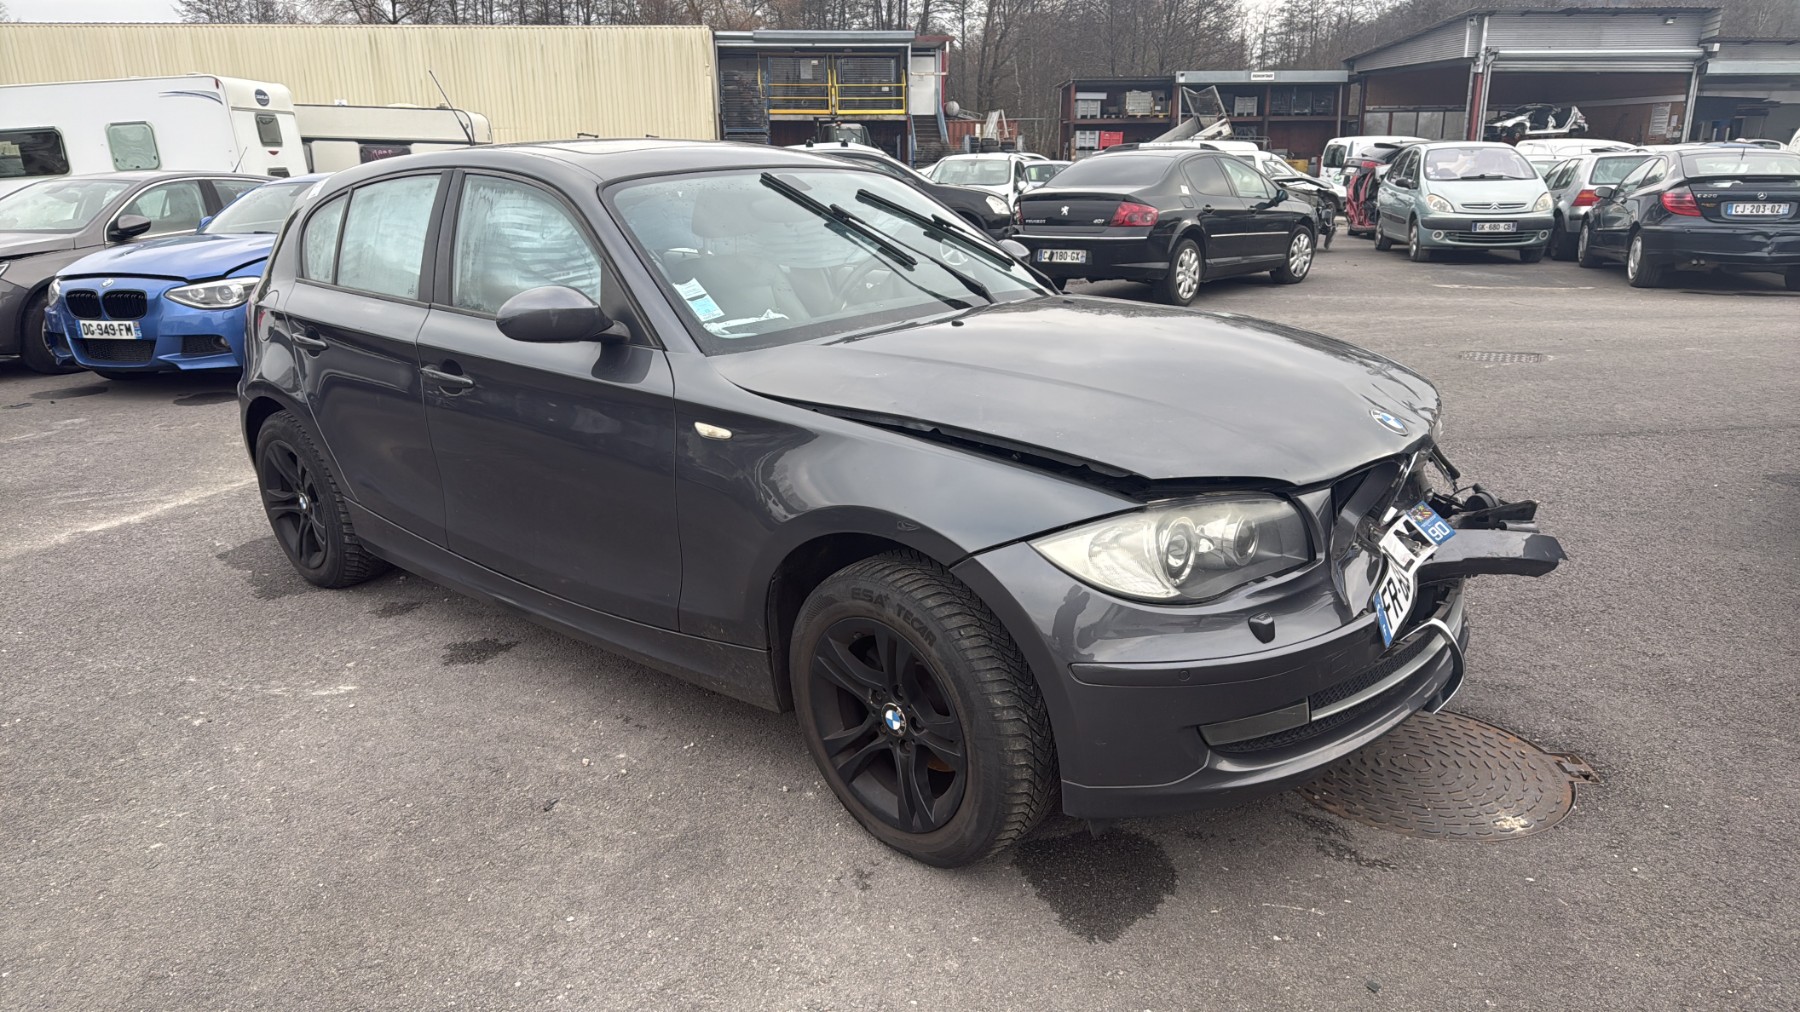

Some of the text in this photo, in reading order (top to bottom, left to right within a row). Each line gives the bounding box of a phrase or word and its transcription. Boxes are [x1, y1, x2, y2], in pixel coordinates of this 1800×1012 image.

[82, 323, 133, 337] DG-949-FM
[1428, 521, 1451, 541] 90
[896, 602, 937, 647] TECAR
